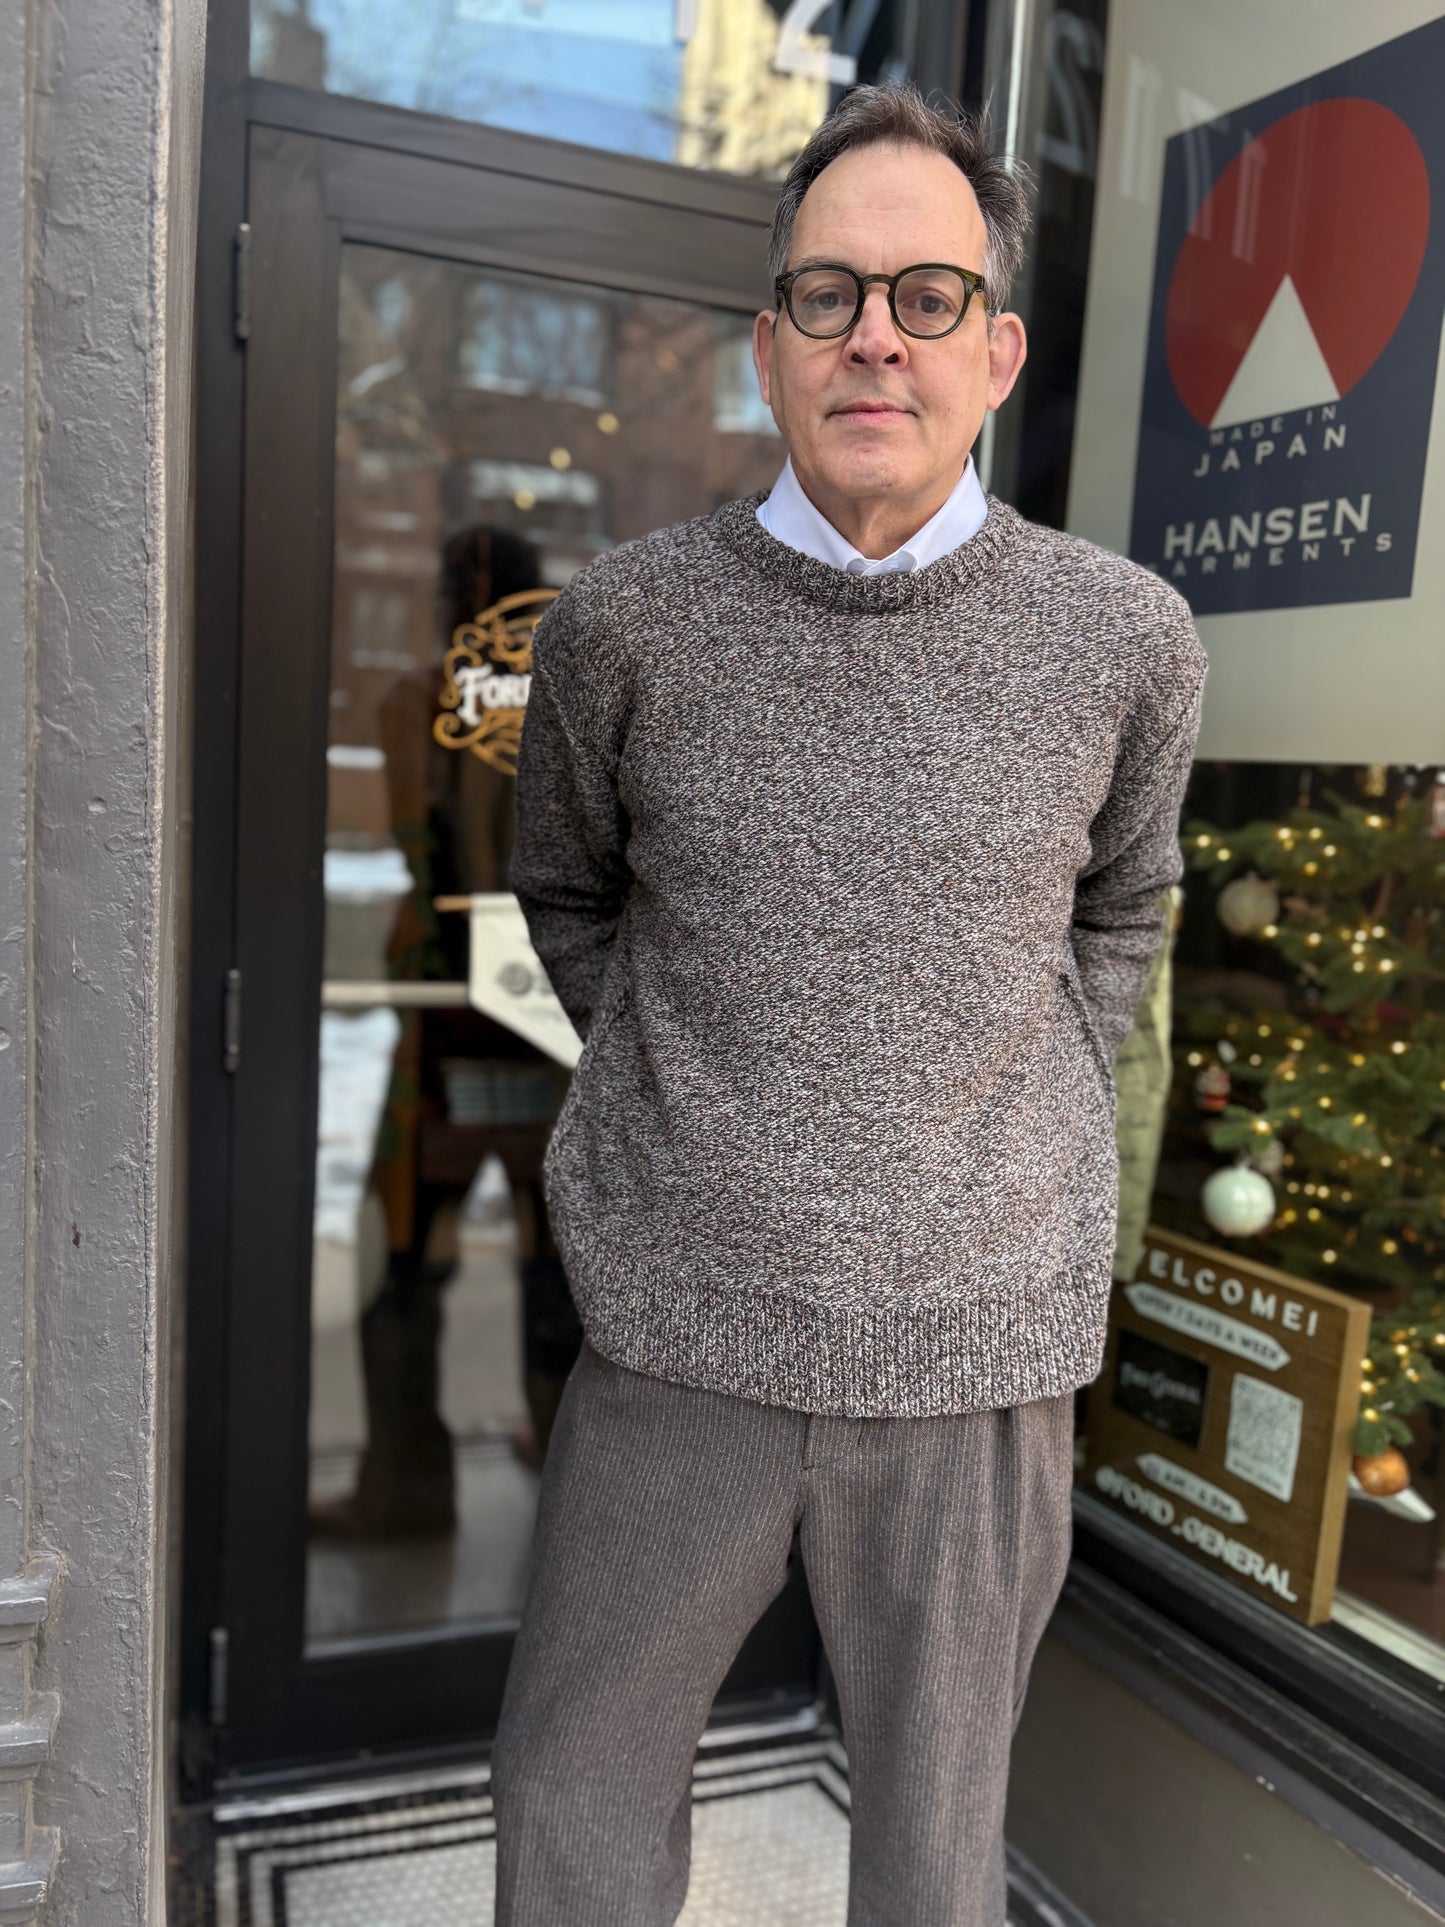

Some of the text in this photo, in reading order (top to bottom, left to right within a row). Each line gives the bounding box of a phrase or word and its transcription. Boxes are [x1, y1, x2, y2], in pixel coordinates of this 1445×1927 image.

[1193, 423, 1348, 478] JAPAN
[1210, 404, 1337, 446] MADE IN
[1164, 493, 1372, 560] HANSEN
[1149, 532, 1393, 577] ARMENTS
[1138, 1245, 1319, 1338] ELCOME!
